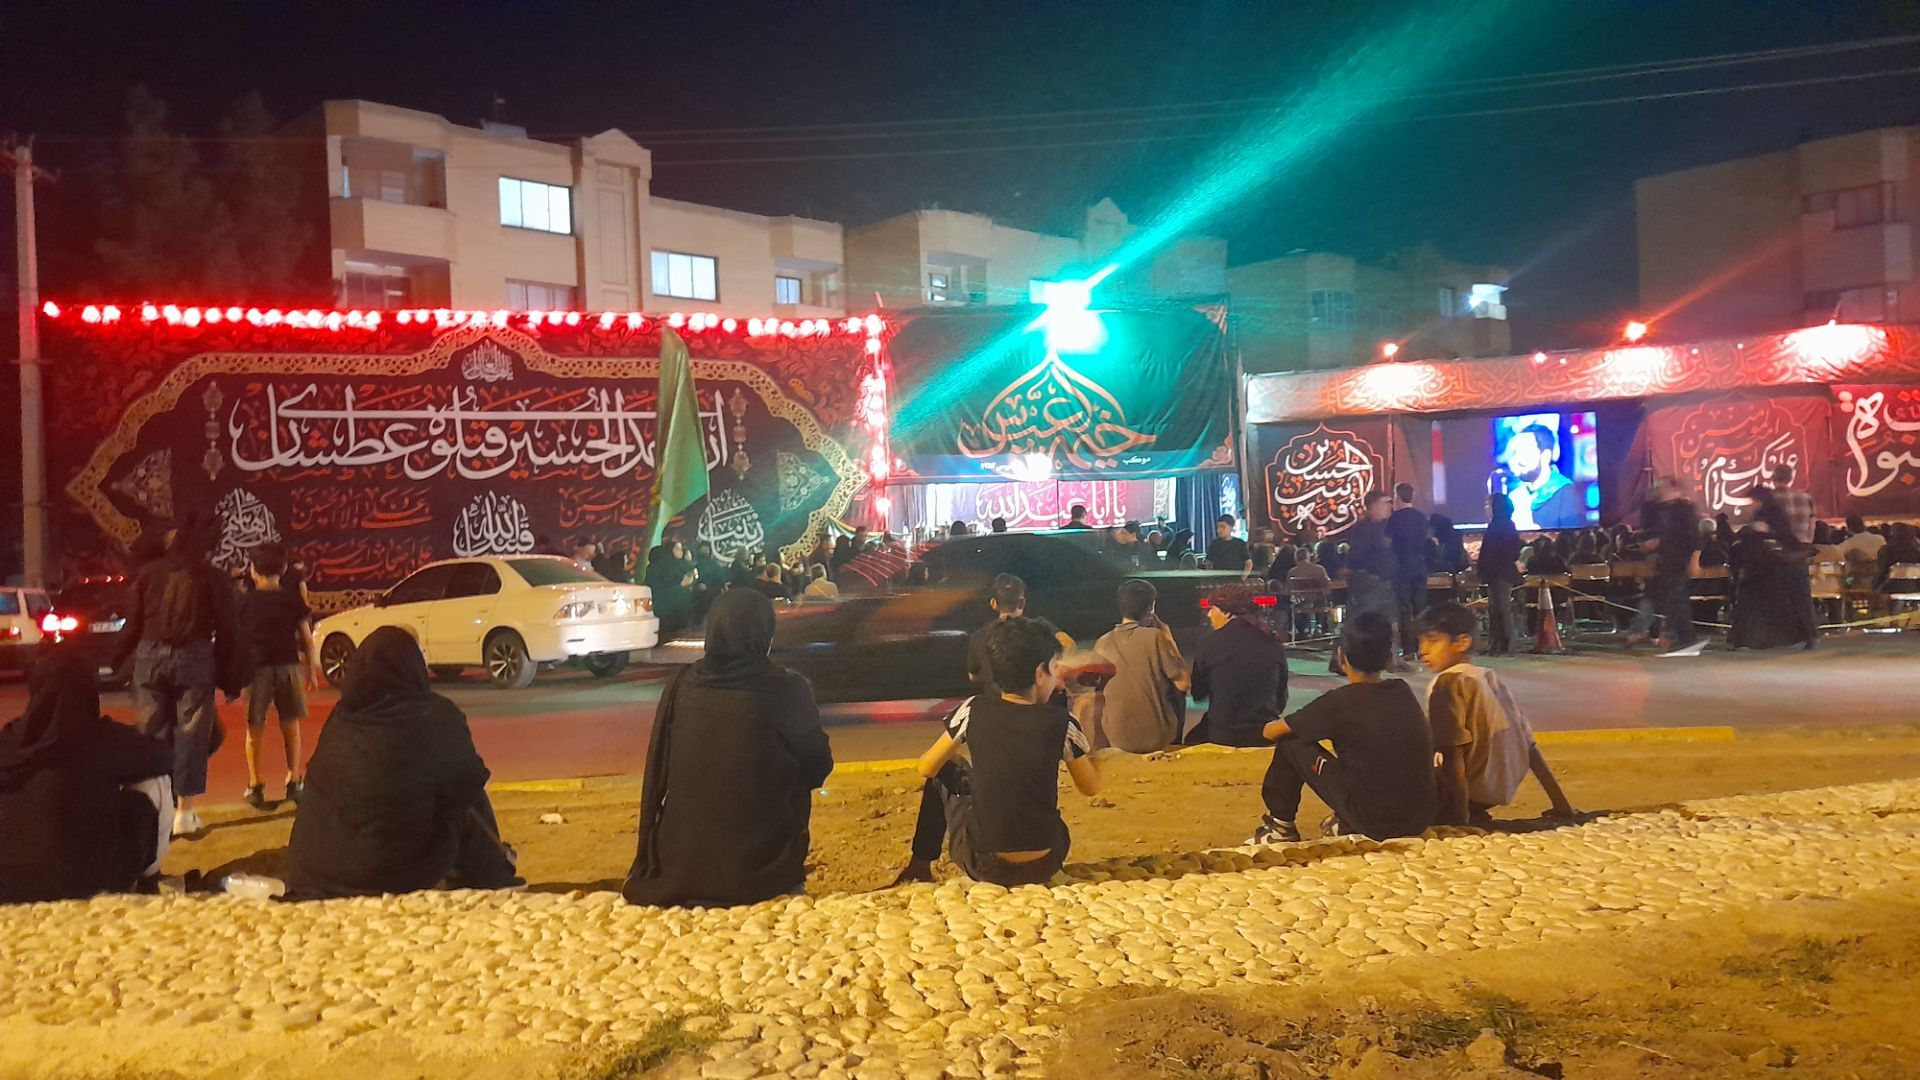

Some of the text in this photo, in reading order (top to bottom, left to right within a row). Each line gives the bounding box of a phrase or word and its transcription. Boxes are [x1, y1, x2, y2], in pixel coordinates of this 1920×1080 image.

[403, 385, 508, 481] قتلوه
[456, 387, 635, 480] الحسین
[1122, 455, 1152, 466] موکب
[1704, 456, 1759, 516] اسلام
[1091, 481, 1111, 525] ابا
[1112, 481, 1128, 525] یا
